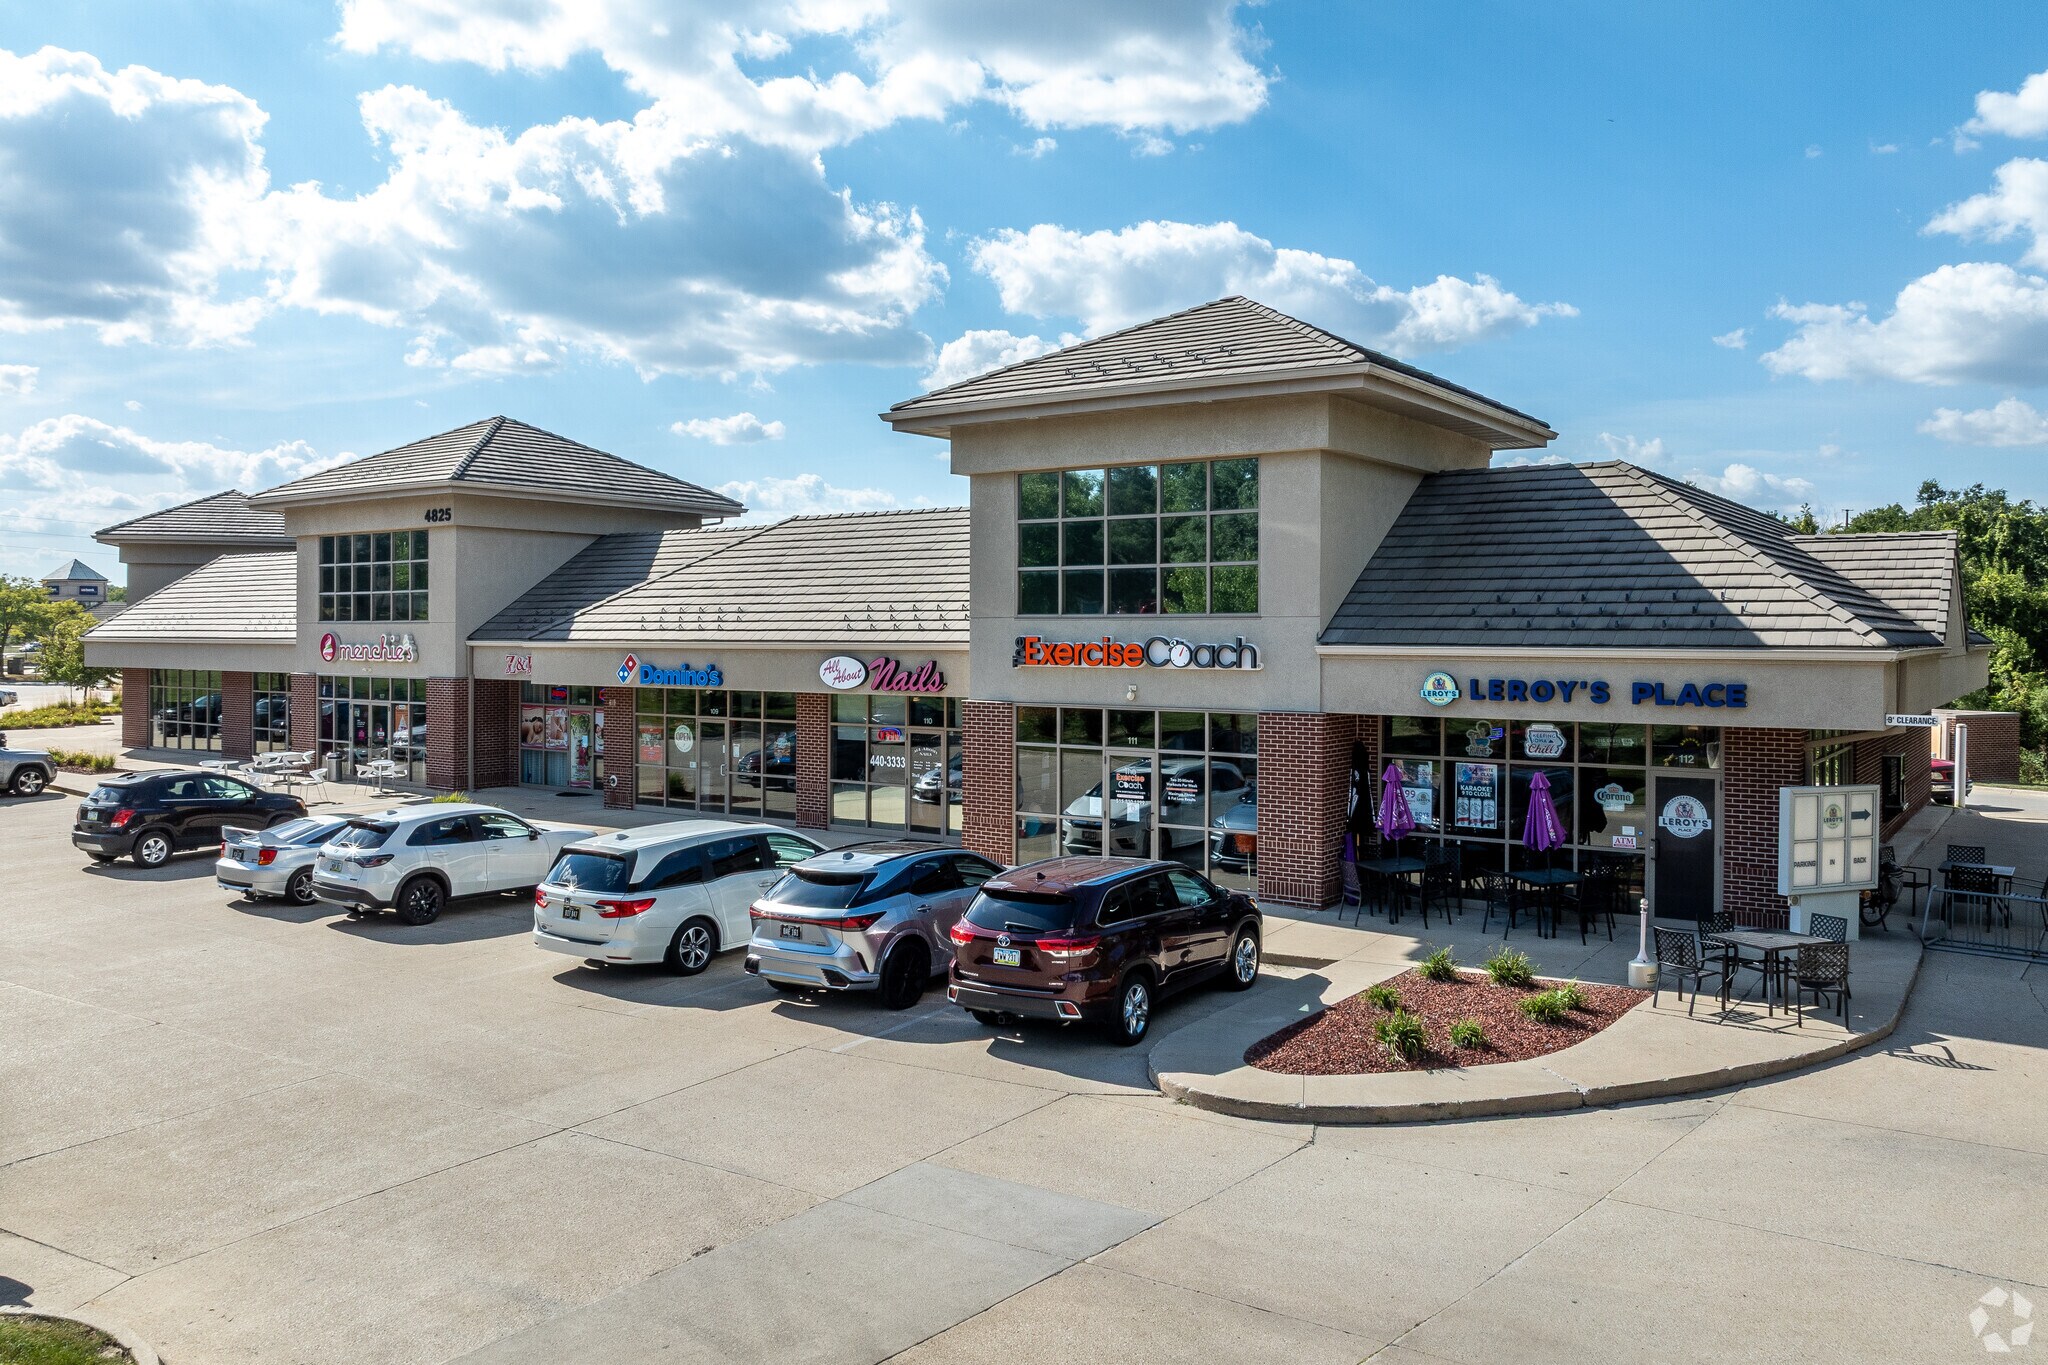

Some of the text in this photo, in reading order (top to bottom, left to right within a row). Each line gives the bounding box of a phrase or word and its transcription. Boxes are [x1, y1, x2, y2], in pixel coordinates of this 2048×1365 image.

[424, 508, 451, 522] 4825
[340, 634, 413, 662] menchie's
[1025, 636, 1144, 667] Exercise
[823, 659, 840, 676] All
[868, 656, 944, 692] Nails
[640, 663, 721, 687] Domino's
[832, 668, 862, 685] About
[1470, 678, 1748, 707] LEROY'S PLACE
[1896, 717, 1937, 725] CLEARANCE
[675, 731, 692, 742] OPEN
[870, 755, 906, 768] 440-3333
[1679, 755, 1695, 763] 112
[1596, 790, 1631, 802] Corona
[1662, 817, 1709, 828] LEROY'S
[1615, 837, 1634, 845] ATM
[1794, 860, 1817, 868] PARKING
